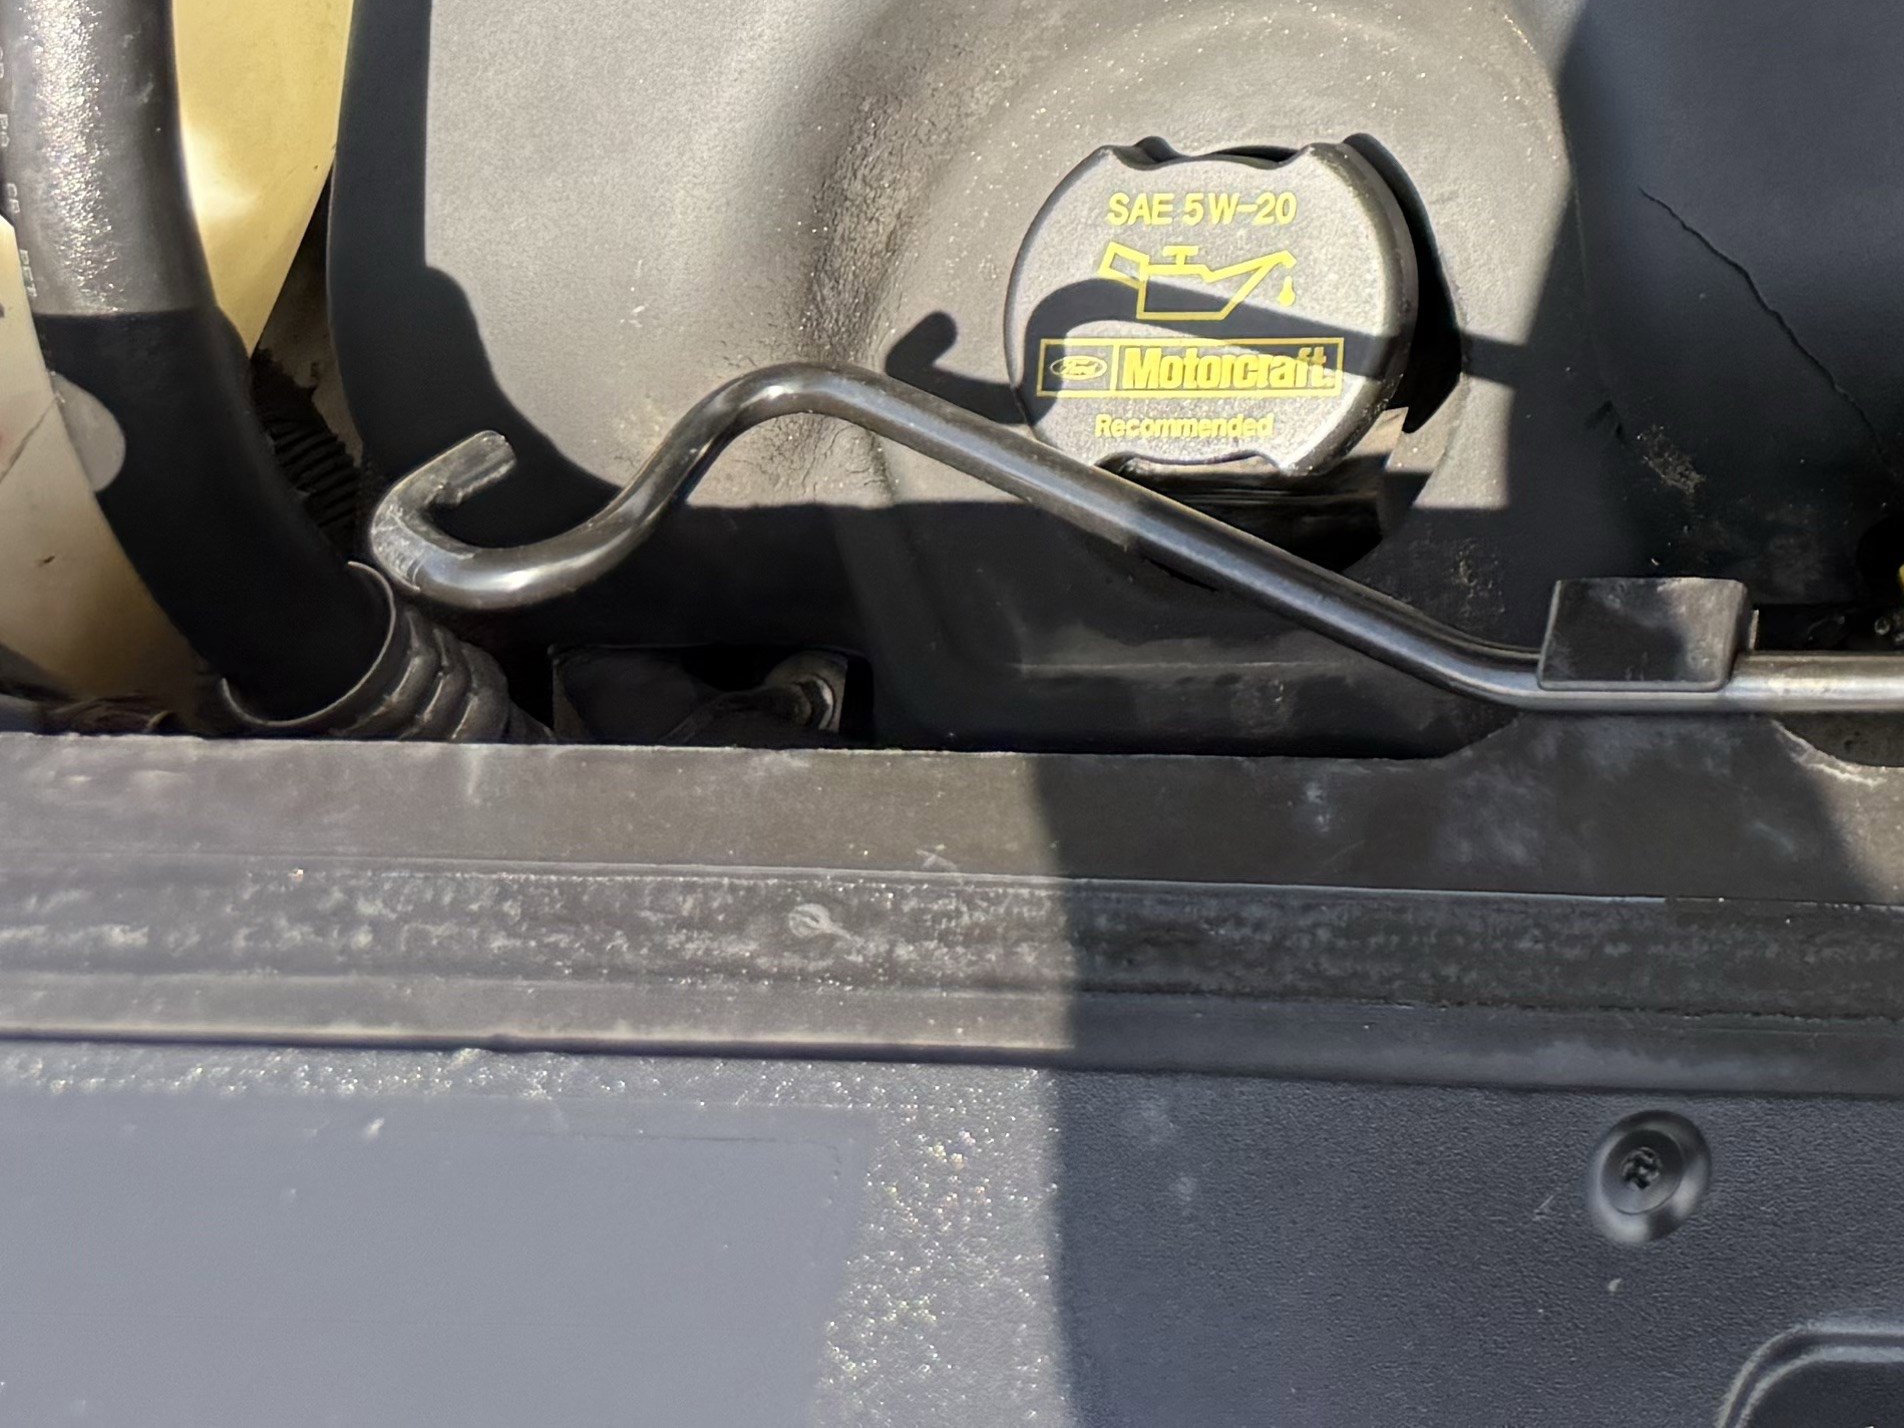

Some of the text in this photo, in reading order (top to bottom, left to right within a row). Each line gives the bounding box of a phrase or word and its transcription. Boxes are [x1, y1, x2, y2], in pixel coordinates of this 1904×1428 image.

[1107, 191, 1297, 226] SAE 5W-20
[1122, 346, 1336, 392] Motorcraft
[1094, 413, 1274, 439] Recommended
